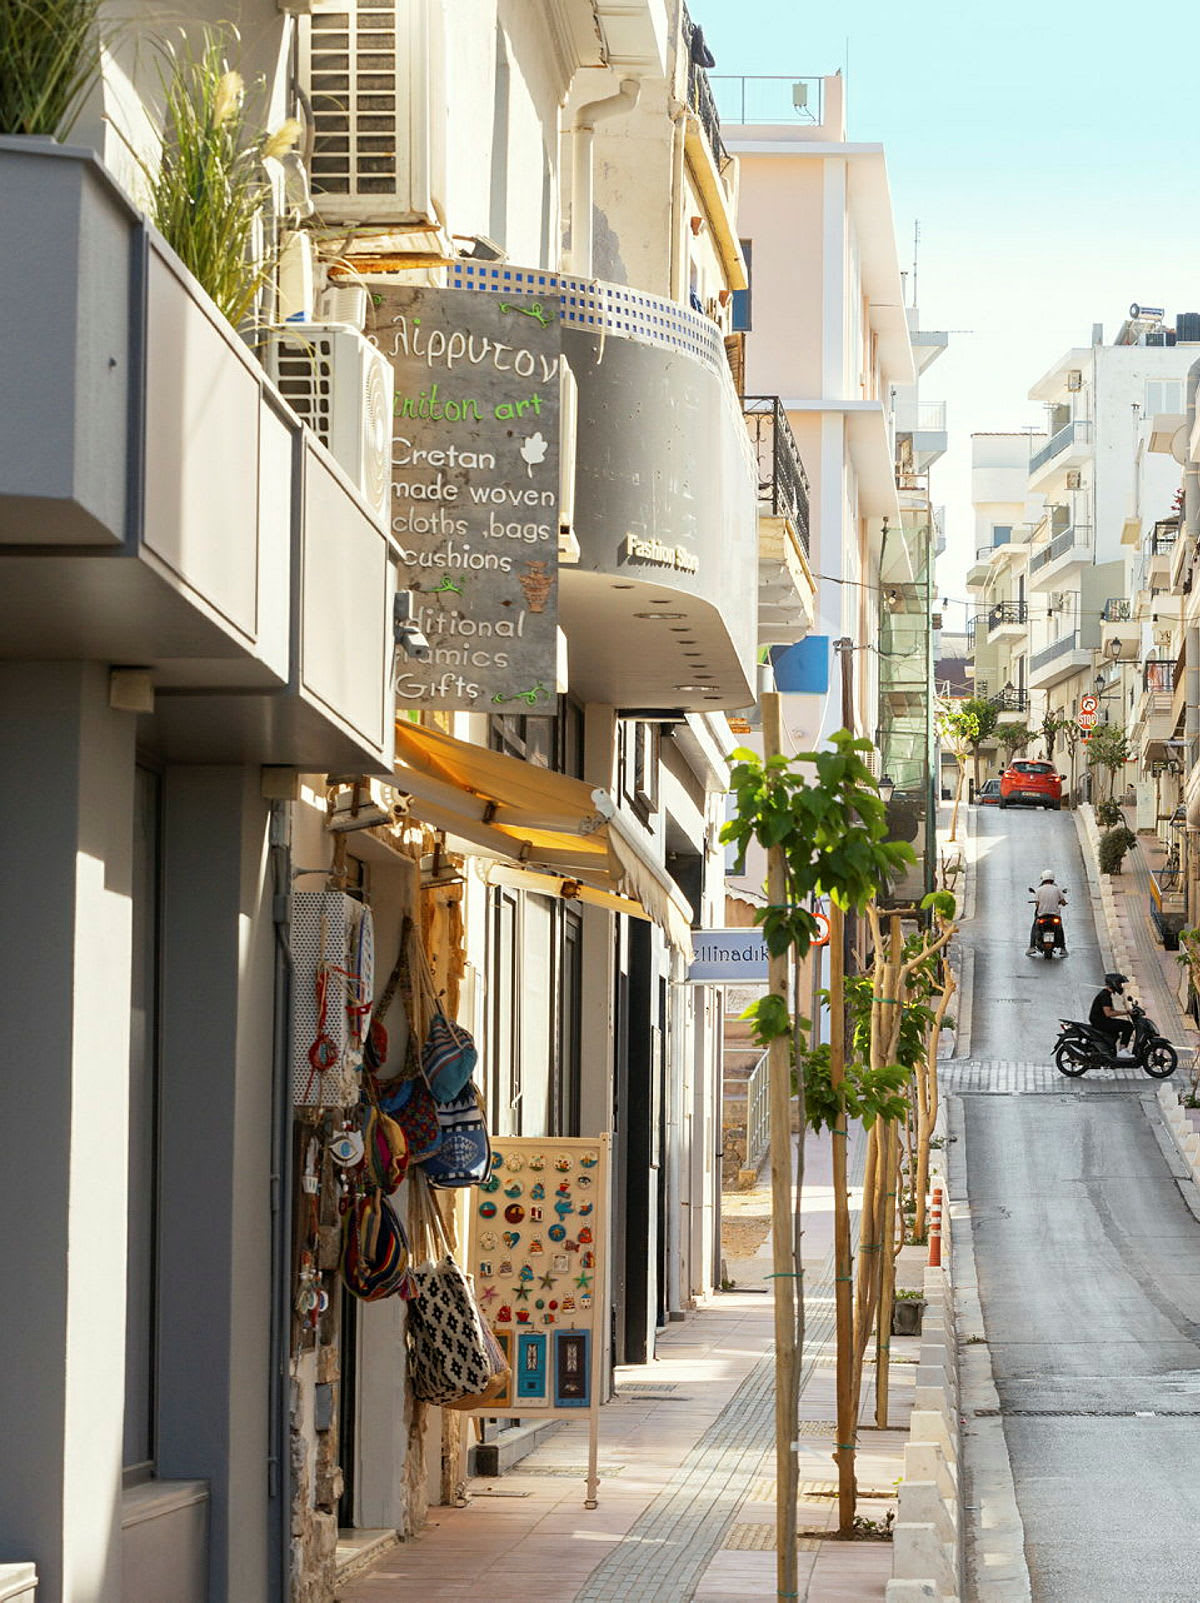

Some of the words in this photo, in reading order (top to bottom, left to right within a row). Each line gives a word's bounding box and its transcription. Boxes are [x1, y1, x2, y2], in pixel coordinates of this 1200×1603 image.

[494, 393, 543, 421] art
[391, 436, 497, 470] Cretan
[390, 472, 459, 501] made
[470, 487, 556, 507] woven
[392, 506, 469, 536] cloths
[404, 541, 513, 573] cushions
[627, 533, 675, 565] Fashion
[405, 606, 526, 638] ditional
[395, 673, 480, 699] Gifts
[1079, 714, 1097, 725] STOP
